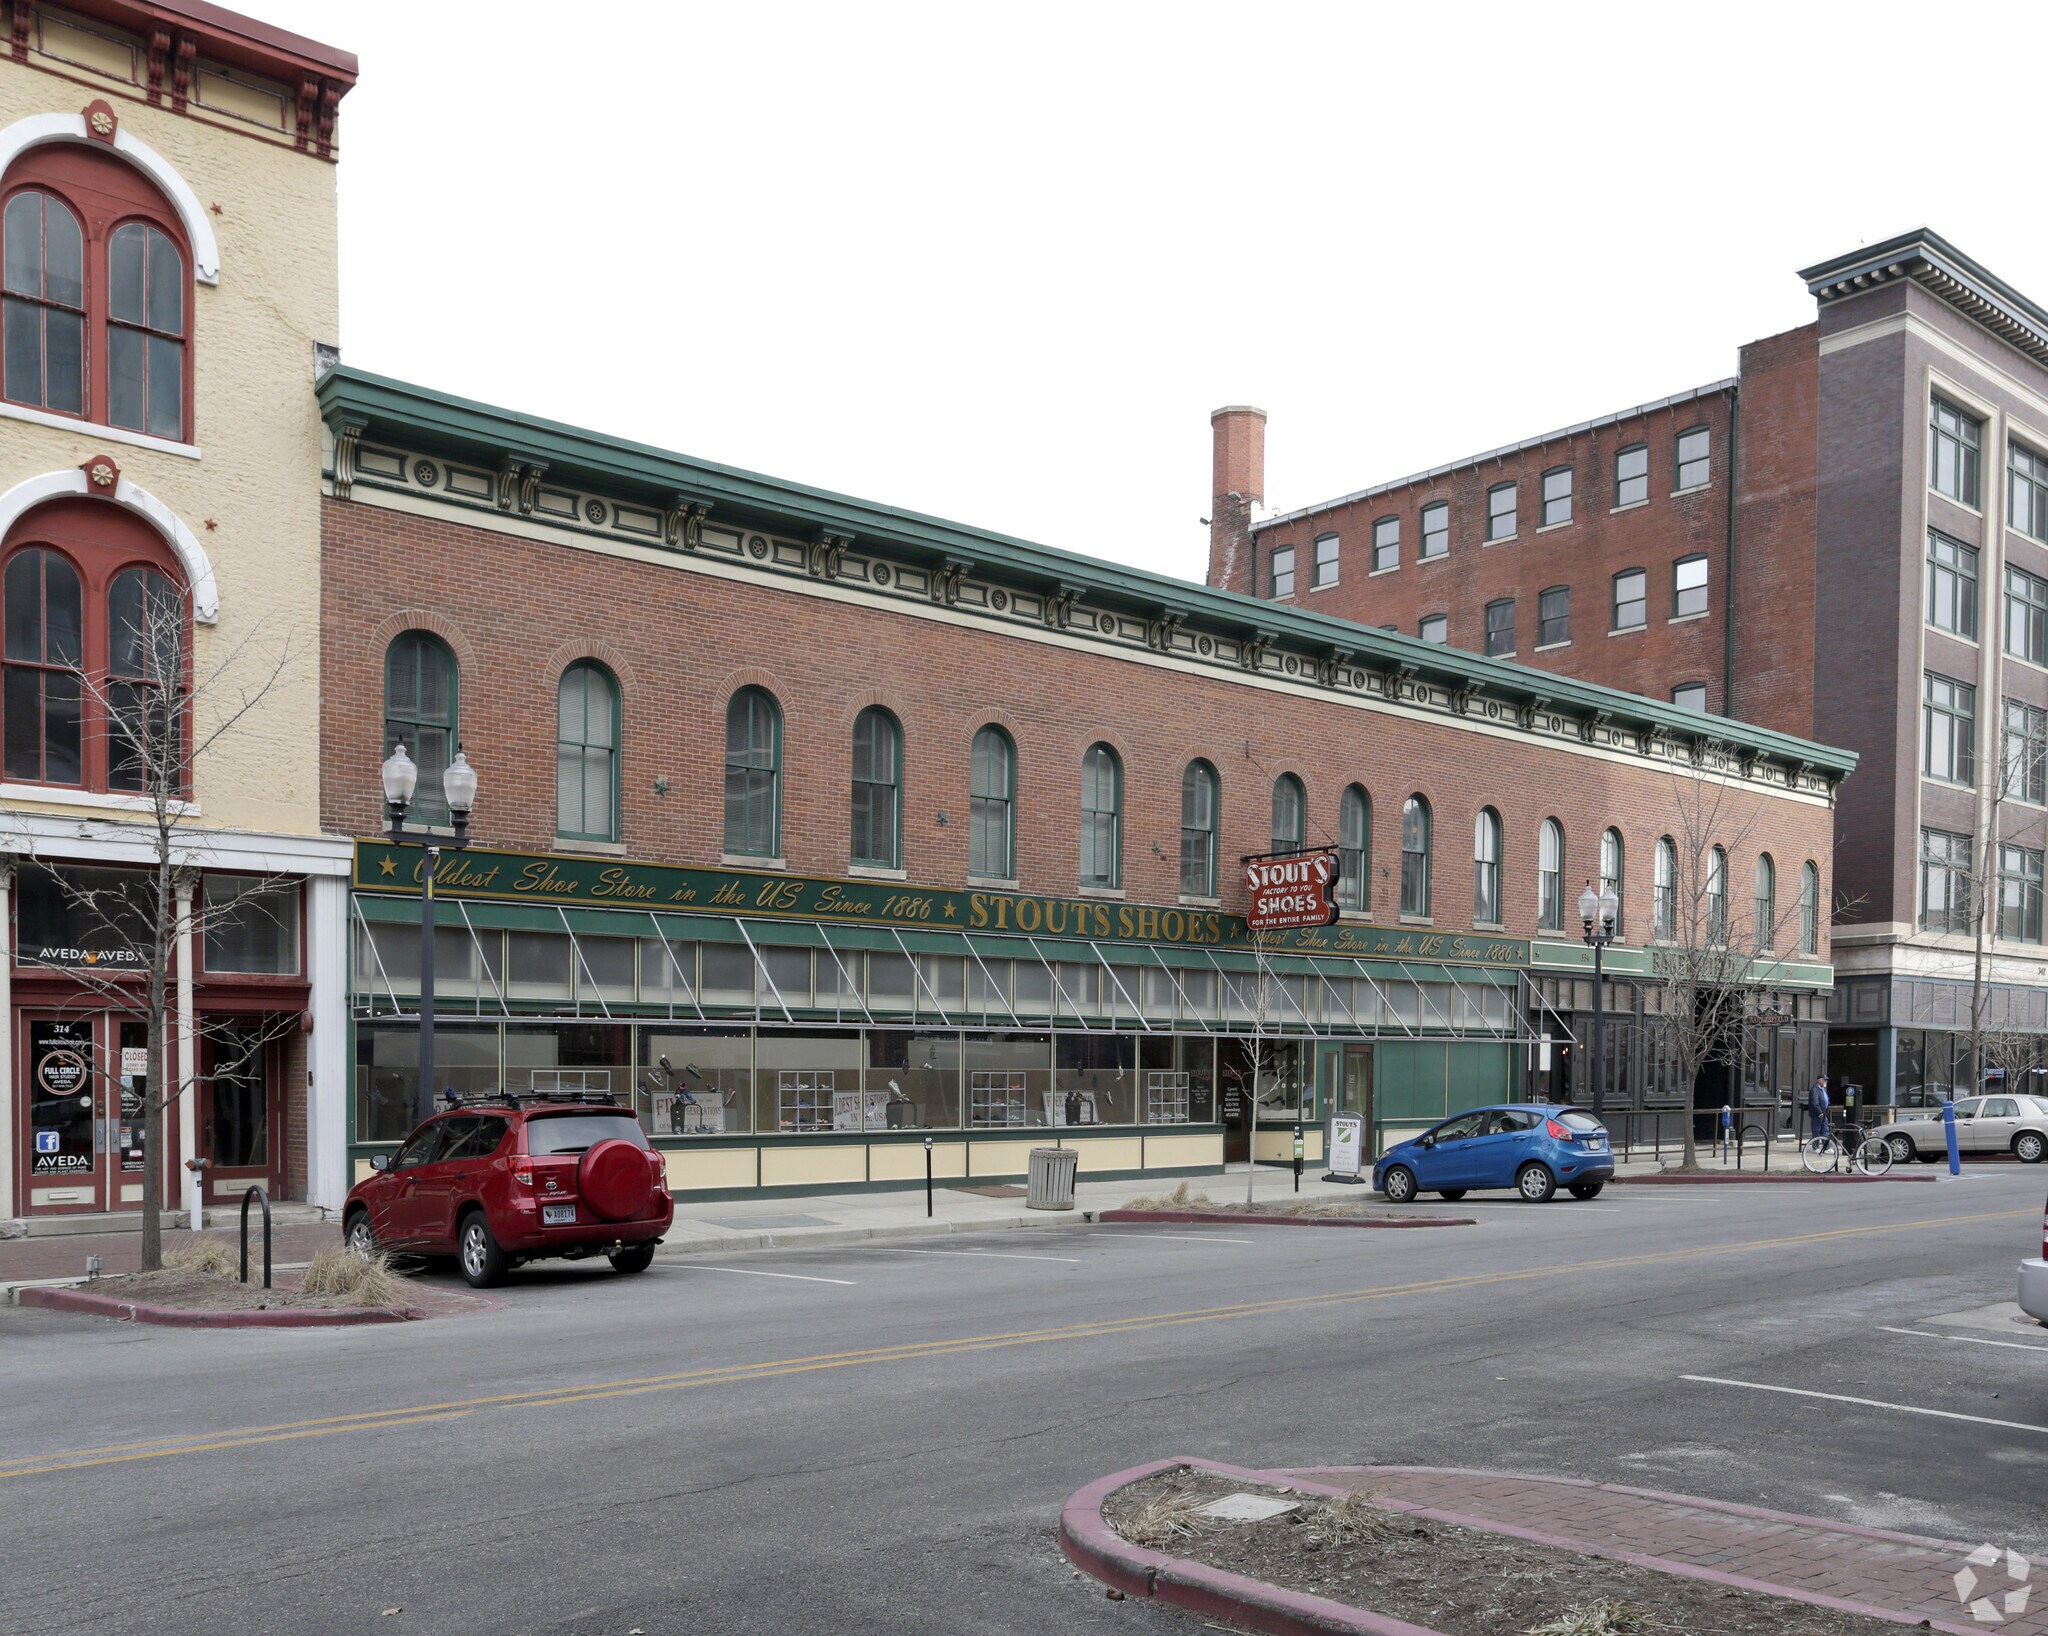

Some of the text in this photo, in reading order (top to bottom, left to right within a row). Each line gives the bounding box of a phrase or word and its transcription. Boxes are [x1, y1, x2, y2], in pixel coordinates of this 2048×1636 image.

[1247, 856, 1328, 891] STOUT'S
[412, 854, 499, 888] Oldest
[513, 861, 579, 895] Shoe
[591, 867, 656, 899] Store
[669, 881, 697, 902] in
[708, 880, 743, 906] the
[757, 880, 804, 910] US
[814, 885, 873, 915] Since
[881, 895, 932, 921] 1886
[1262, 886, 1288, 895] FACTORY
[1257, 893, 1317, 915] SHOES
[970, 892, 1221, 945] STOUTS SHOES
[1279, 916, 1300, 924] ENTIRE
[1302, 914, 1325, 922] FAMILY
[1295, 926, 1327, 949] Shoe
[1333, 928, 1369, 951] Store
[1374, 937, 1391, 952] in
[1395, 936, 1413, 955] the
[1418, 936, 1443, 956] US
[1448, 938, 1481, 958] Since
[1485, 943, 1512, 962] 1886
[39, 947, 91, 960] AVEDA
[53, 1024, 70, 1033] 314
[36, 1155, 88, 1167] AVEDA
